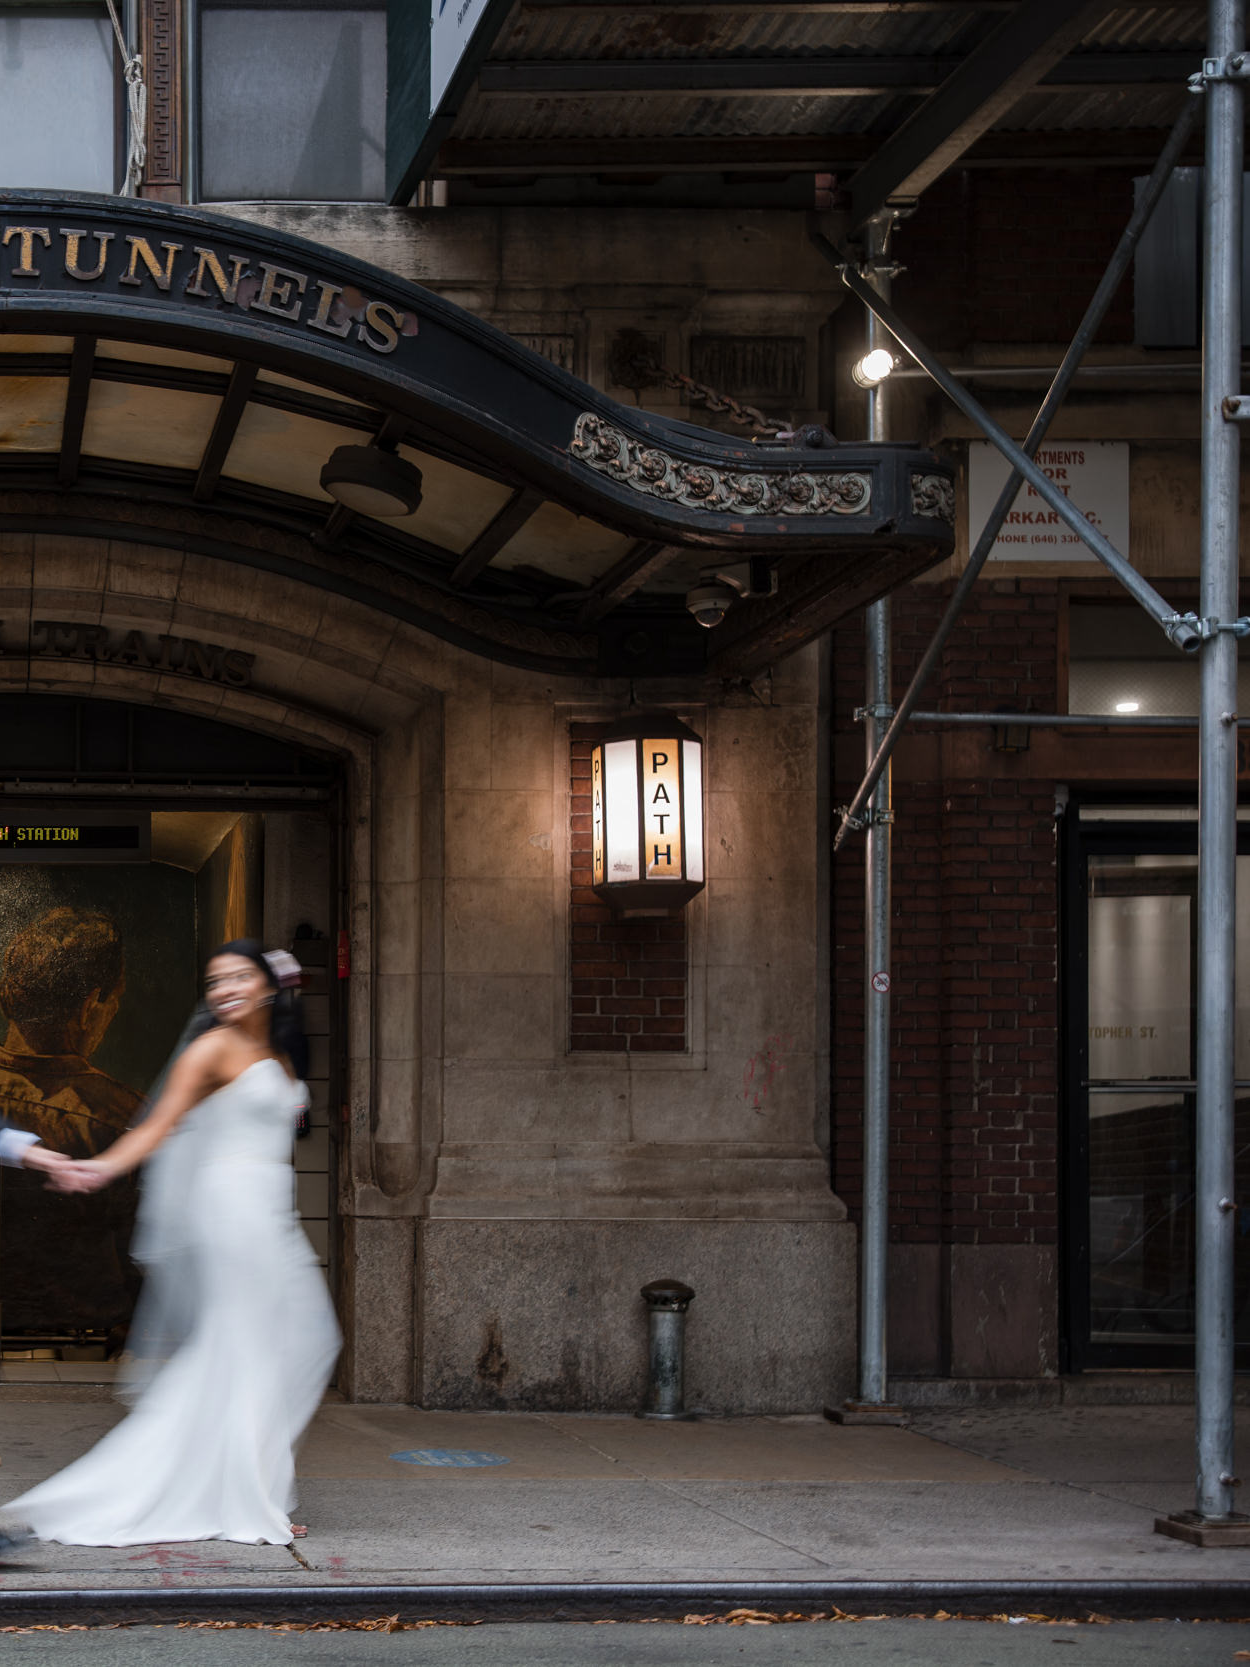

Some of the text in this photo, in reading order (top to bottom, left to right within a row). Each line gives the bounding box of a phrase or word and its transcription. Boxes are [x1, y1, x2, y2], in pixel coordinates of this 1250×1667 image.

[1, 225, 405, 354] TUNNELS
[1034, 451, 1085, 465] RTMENTS
[1042, 467, 1068, 480] OR
[1027, 485, 1071, 497] RT
[996, 534, 1028, 544] HONE
[33, 620, 256, 687] TRAINS
[652, 752, 672, 865] PATH
[17, 827, 79, 841] STATION
[1089, 1026, 1158, 1039] TOPHER ST.
